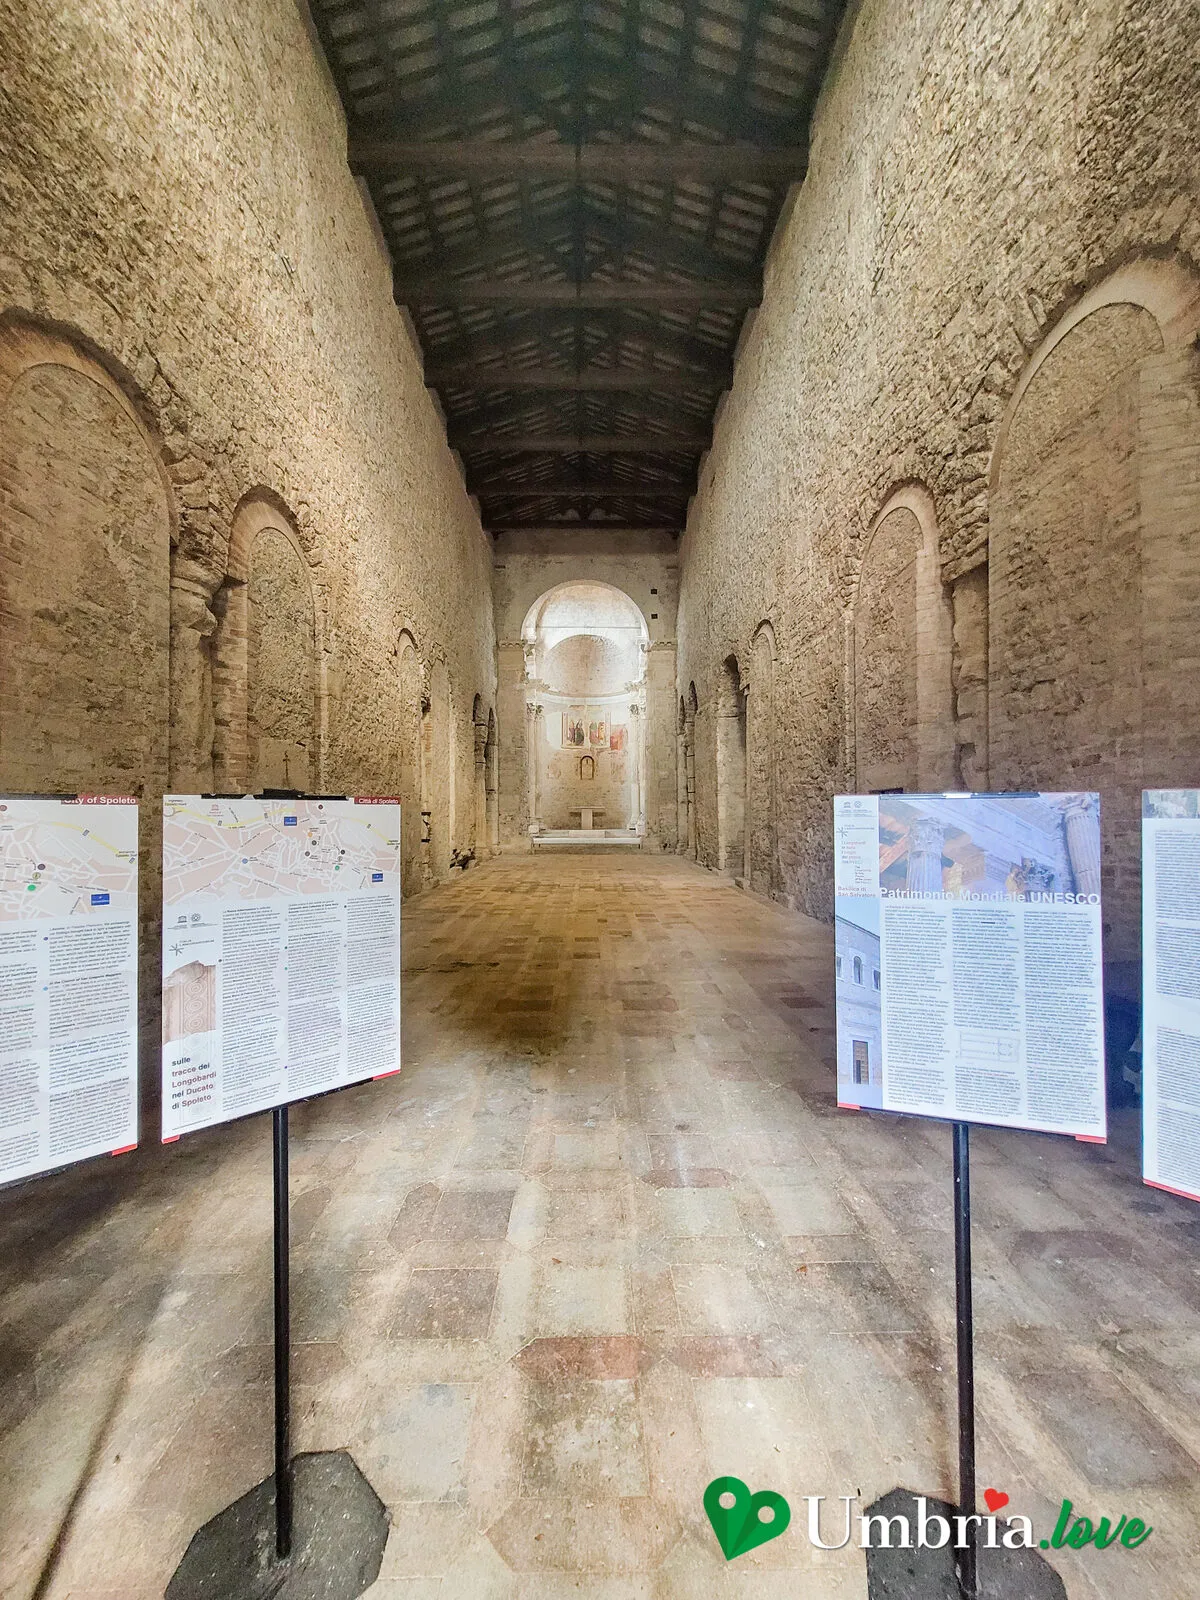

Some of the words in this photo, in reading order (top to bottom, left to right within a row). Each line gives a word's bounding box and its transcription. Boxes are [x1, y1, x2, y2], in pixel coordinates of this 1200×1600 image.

[100, 797, 136, 805] Spoleto
[880, 887, 954, 900] Patrimonio
[959, 888, 1026, 903] Mondiale
[1030, 891, 1100, 905] UNESCO
[172, 1057, 191, 1066] sulle
[172, 1066, 197, 1077] tracce
[198, 1062, 210, 1071] dei
[172, 1071, 217, 1088] Longobardi
[172, 1090, 184, 1099] nel
[186, 1083, 214, 1095] Ducato
[172, 1102, 180, 1110] di
[181, 1094, 212, 1107] Spoleto
